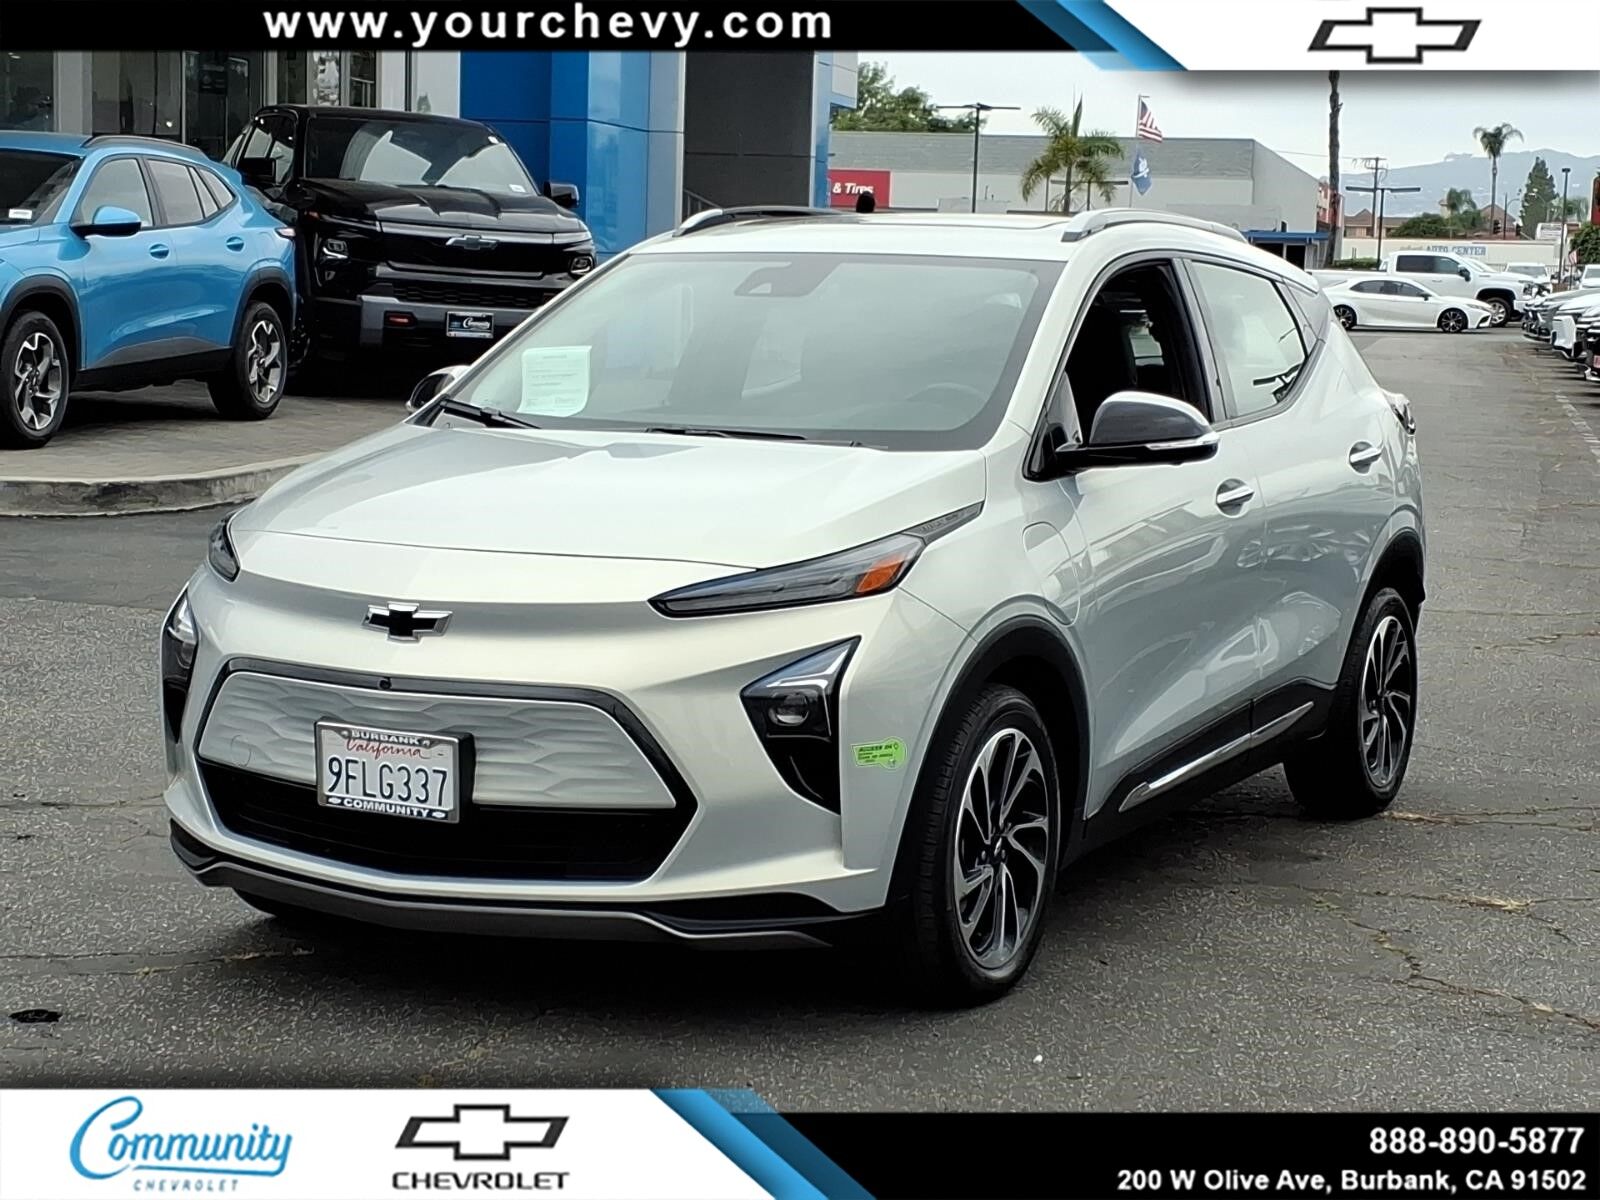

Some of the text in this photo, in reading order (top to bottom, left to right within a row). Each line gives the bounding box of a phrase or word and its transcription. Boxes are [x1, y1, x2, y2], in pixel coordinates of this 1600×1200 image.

[832, 182, 841, 194] &
[1453, 245, 1487, 256] CENTER
[351, 730, 420, 745] BURBANK
[346, 739, 431, 760] California
[328, 757, 447, 807] 9FLG337
[343, 798, 430, 818] COMMUNITY
